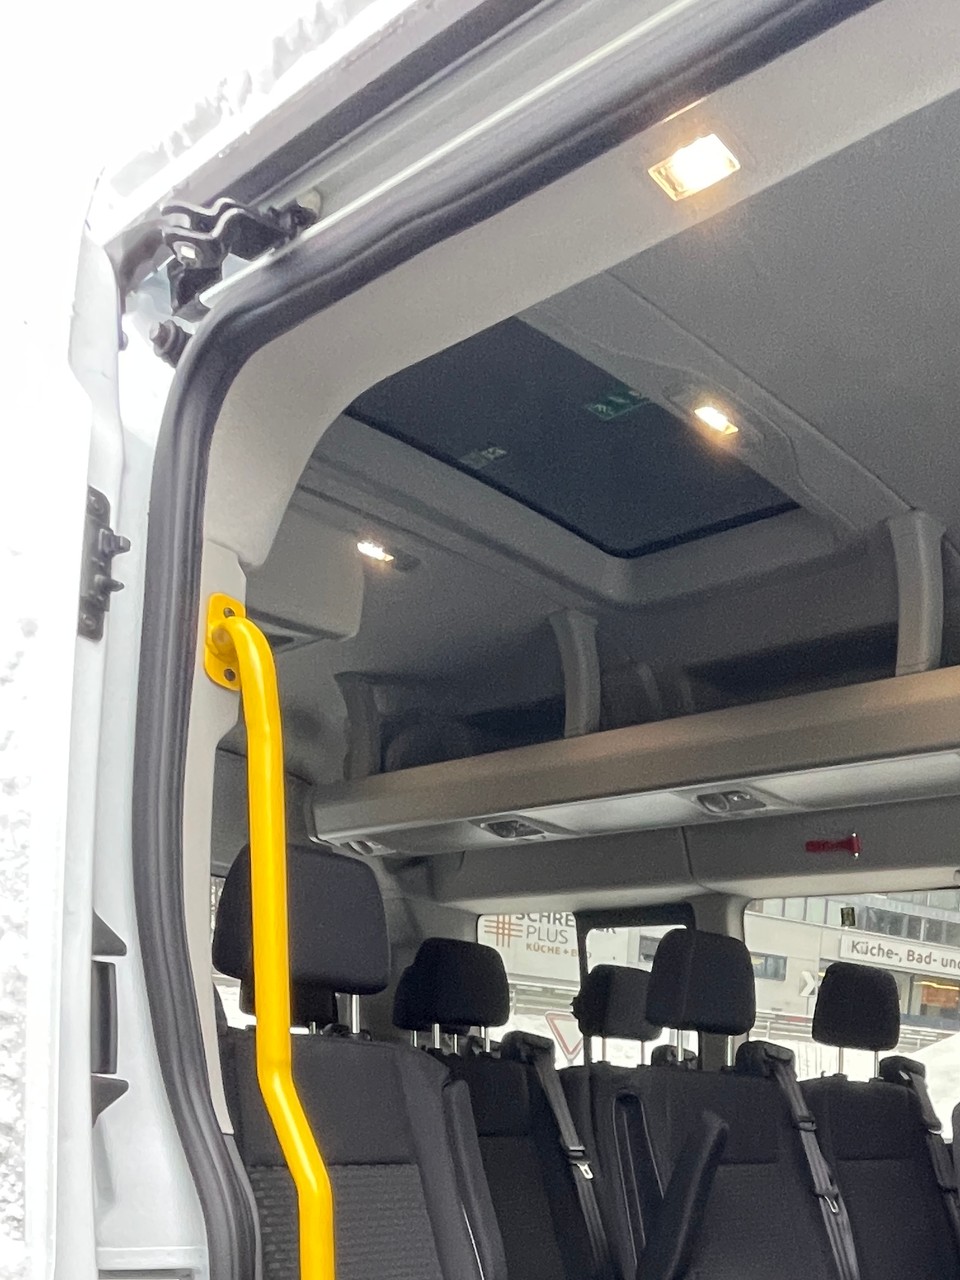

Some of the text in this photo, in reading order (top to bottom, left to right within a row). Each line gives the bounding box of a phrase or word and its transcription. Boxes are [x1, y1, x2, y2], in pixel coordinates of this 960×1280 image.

[526, 925, 568, 944] PLUS
[526, 942, 560, 955] KÜCHE
[851, 940, 903, 962] Küche-,
[906, 949, 938, 965] Bad-
